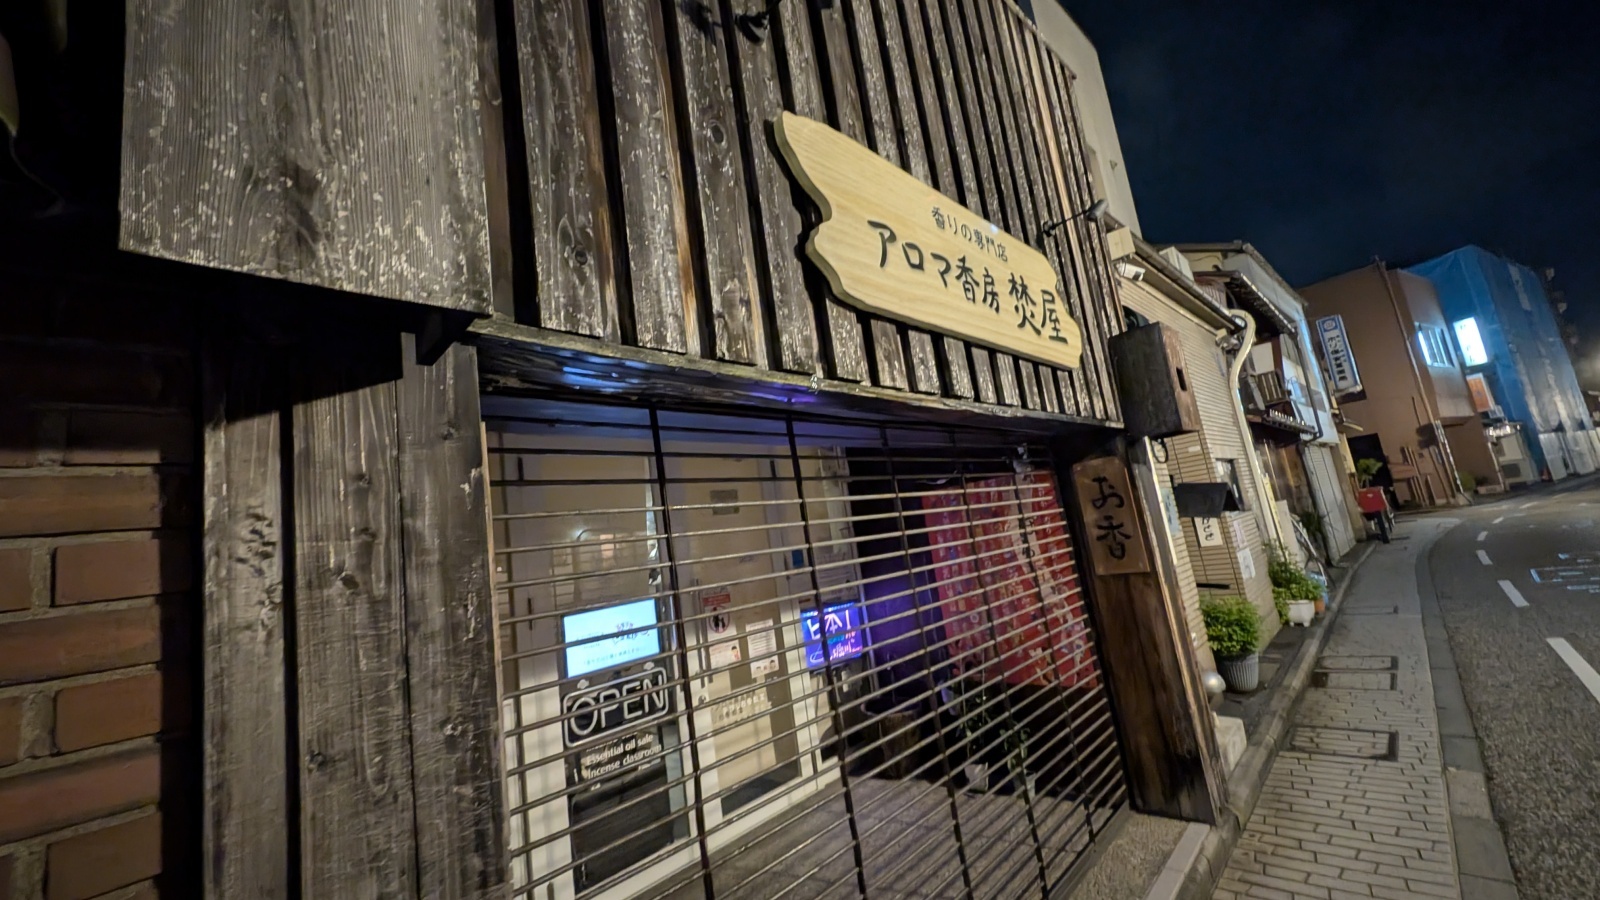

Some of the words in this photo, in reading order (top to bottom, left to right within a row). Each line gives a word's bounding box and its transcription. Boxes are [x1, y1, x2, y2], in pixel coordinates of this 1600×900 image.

[867, 219, 1000, 313] アロマ香房
[1008, 272, 1068, 344] 焚屋
[1091, 475, 1132, 560] お香
[571, 674, 664, 736] OPEN
[587, 743, 624, 766] Essential
[625, 739, 636, 751] oil
[637, 734, 654, 747] sale
[588, 760, 620, 779] Incense
[622, 744, 662, 766] classroom
